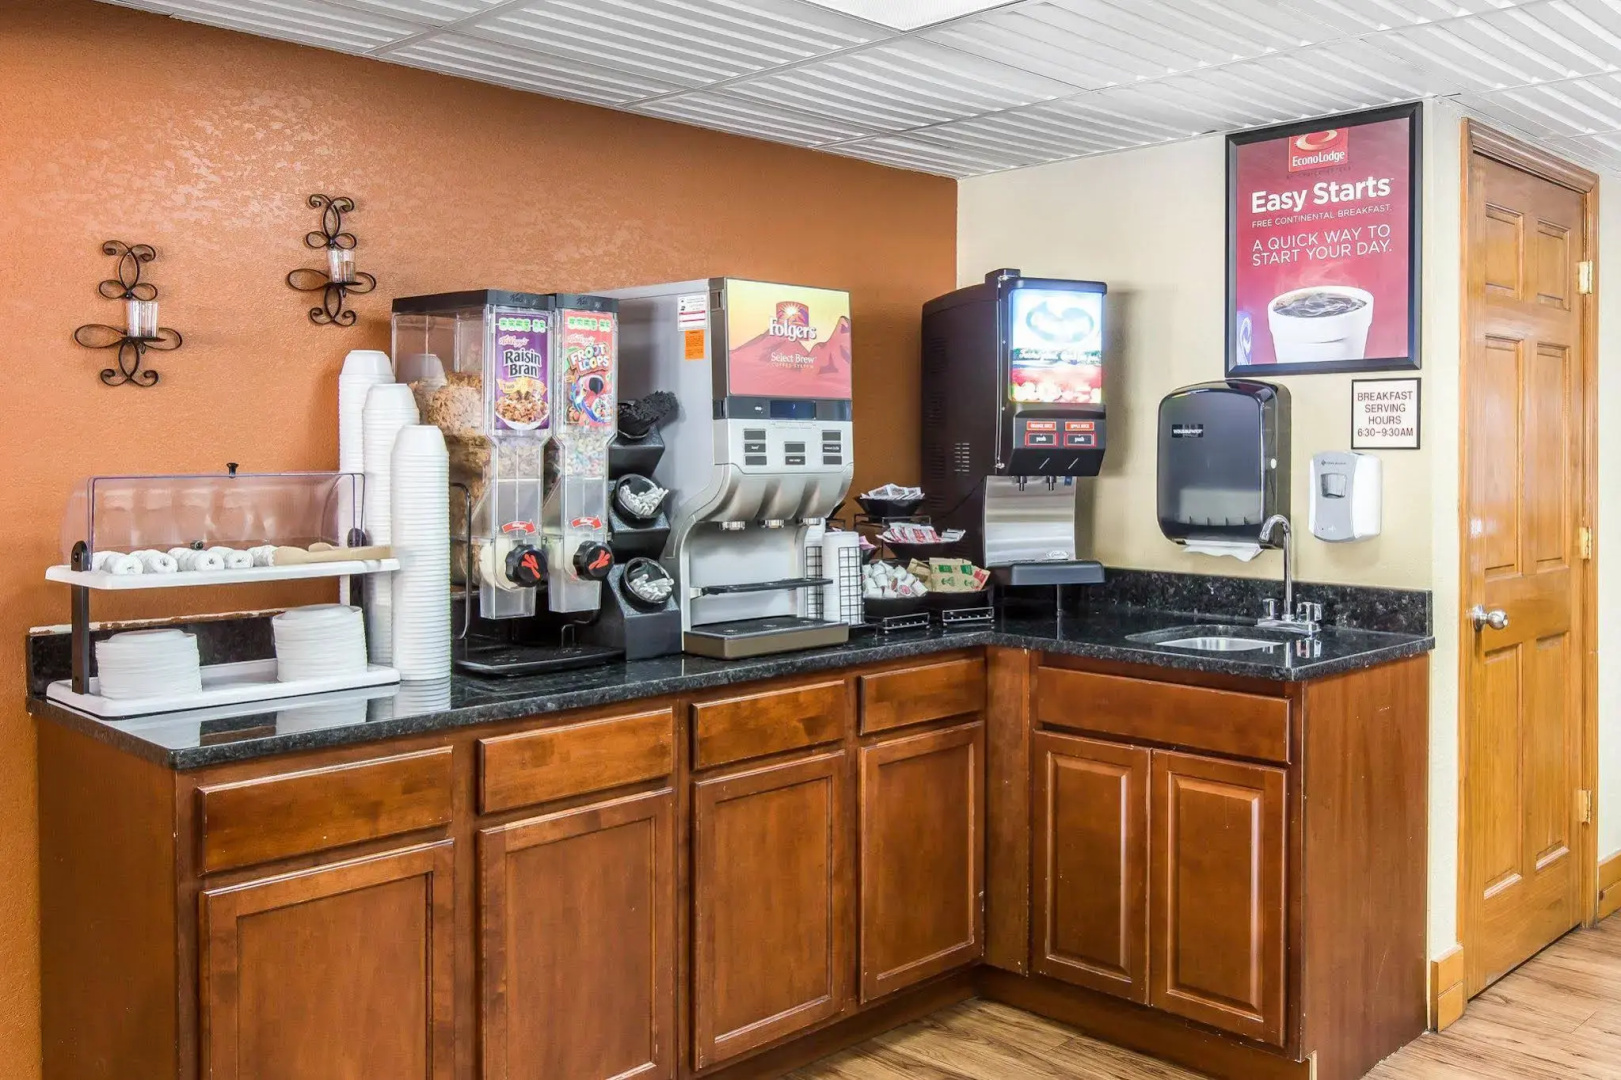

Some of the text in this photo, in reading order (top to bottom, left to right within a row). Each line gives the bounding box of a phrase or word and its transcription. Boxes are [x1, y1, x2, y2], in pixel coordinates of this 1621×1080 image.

[1292, 150, 1345, 167] EconoLodge
[1251, 176, 1391, 214] Easy Starts
[1251, 219, 1273, 228] FREE
[1275, 212, 1334, 225] CONTINENTAL
[1252, 224, 1391, 252] A QUICK WAY TO
[1252, 239, 1393, 267] START YOUR DAY.
[769, 316, 817, 342] Folgers
[505, 348, 541, 366] Raisin
[570, 344, 606, 367] FROOT
[579, 356, 609, 371] LOOPS
[771, 352, 815, 364] Select Brew
[510, 363, 538, 377] Bran
[1357, 391, 1413, 401] BREAKFAST
[1364, 403, 1406, 413] SERVING
[1368, 415, 1402, 425] HOURS
